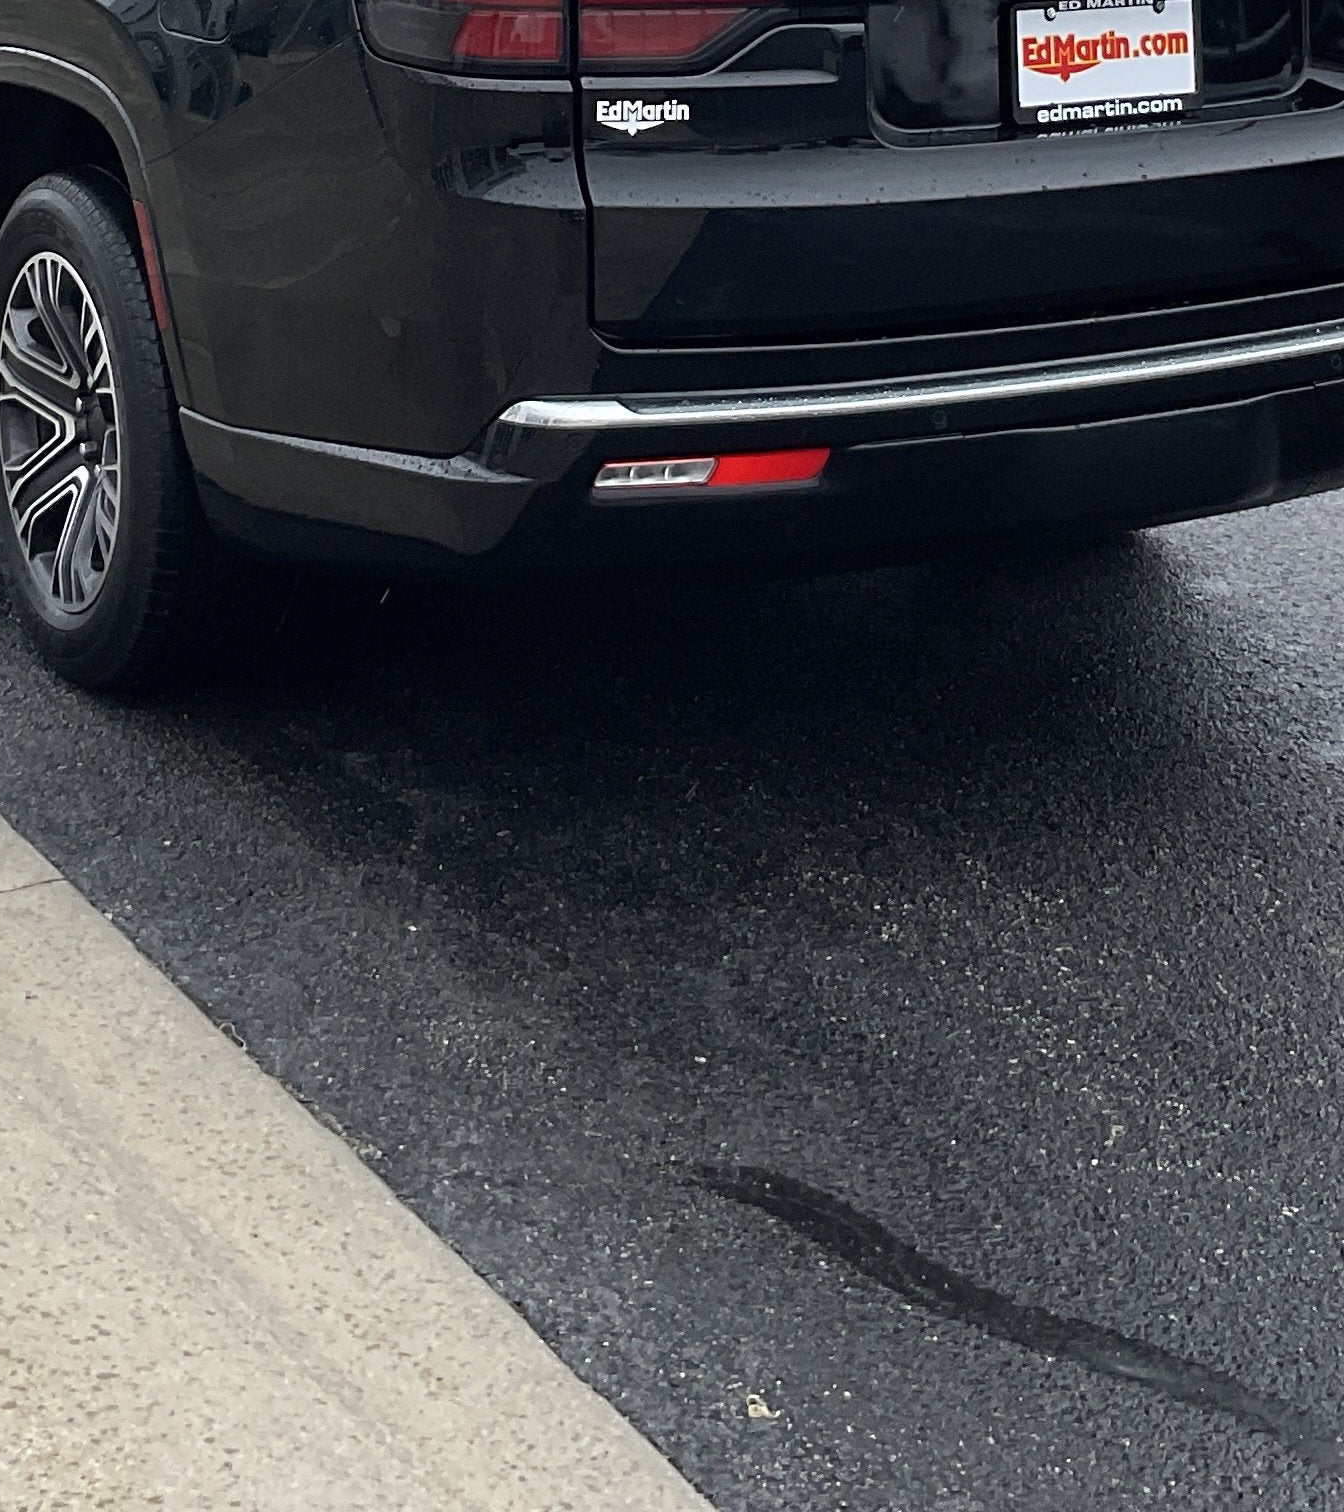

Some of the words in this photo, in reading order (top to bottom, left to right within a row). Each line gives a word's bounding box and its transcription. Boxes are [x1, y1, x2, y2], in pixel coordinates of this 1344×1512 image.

[1058, 0, 1082, 11] ED
[596, 99, 691, 126] EdMartin
[1036, 98, 1184, 124] edmartin.com
